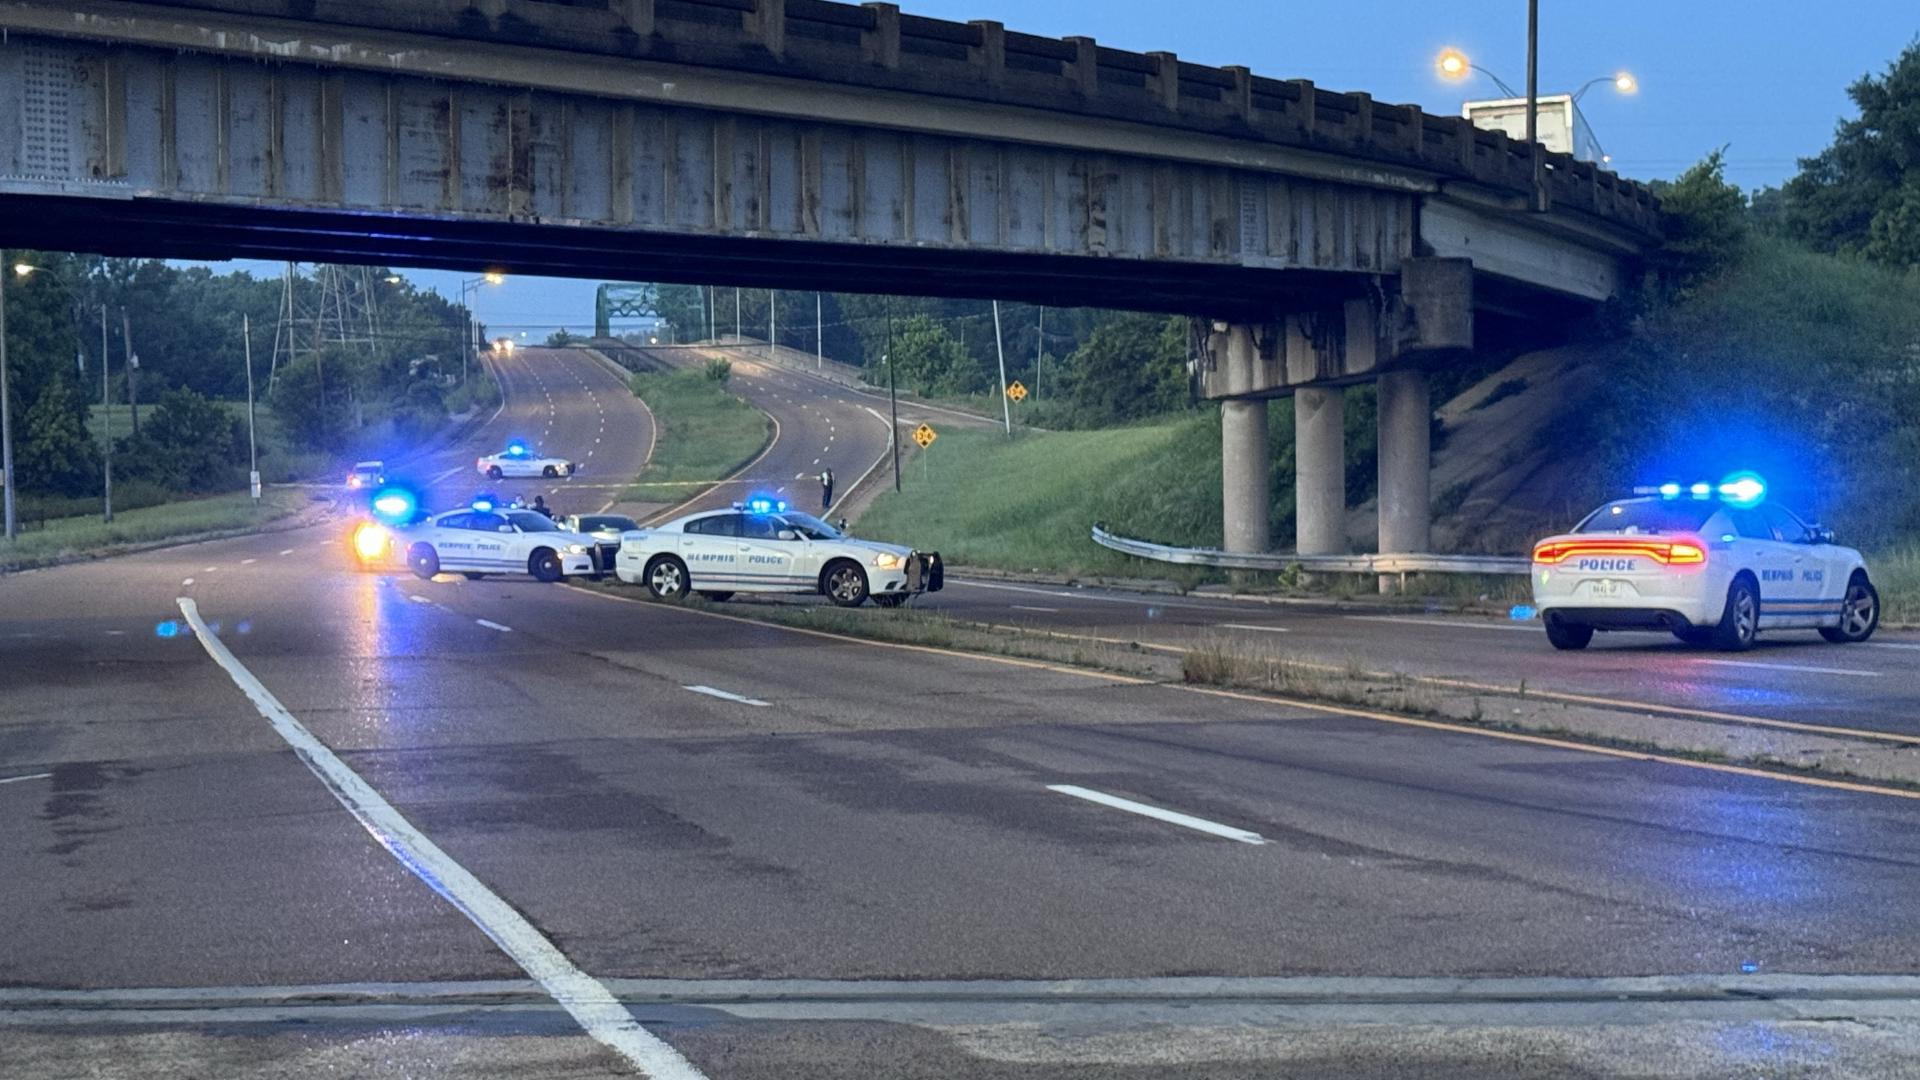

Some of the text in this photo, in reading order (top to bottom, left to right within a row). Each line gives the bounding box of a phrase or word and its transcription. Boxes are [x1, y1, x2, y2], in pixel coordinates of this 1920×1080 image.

[474, 543, 501, 551] POLICE
[686, 552, 785, 565] MEMPHIS POLICE
[1579, 559, 1637, 571] POLICE
[1761, 569, 1822, 582] MEMPHIS POLICE
